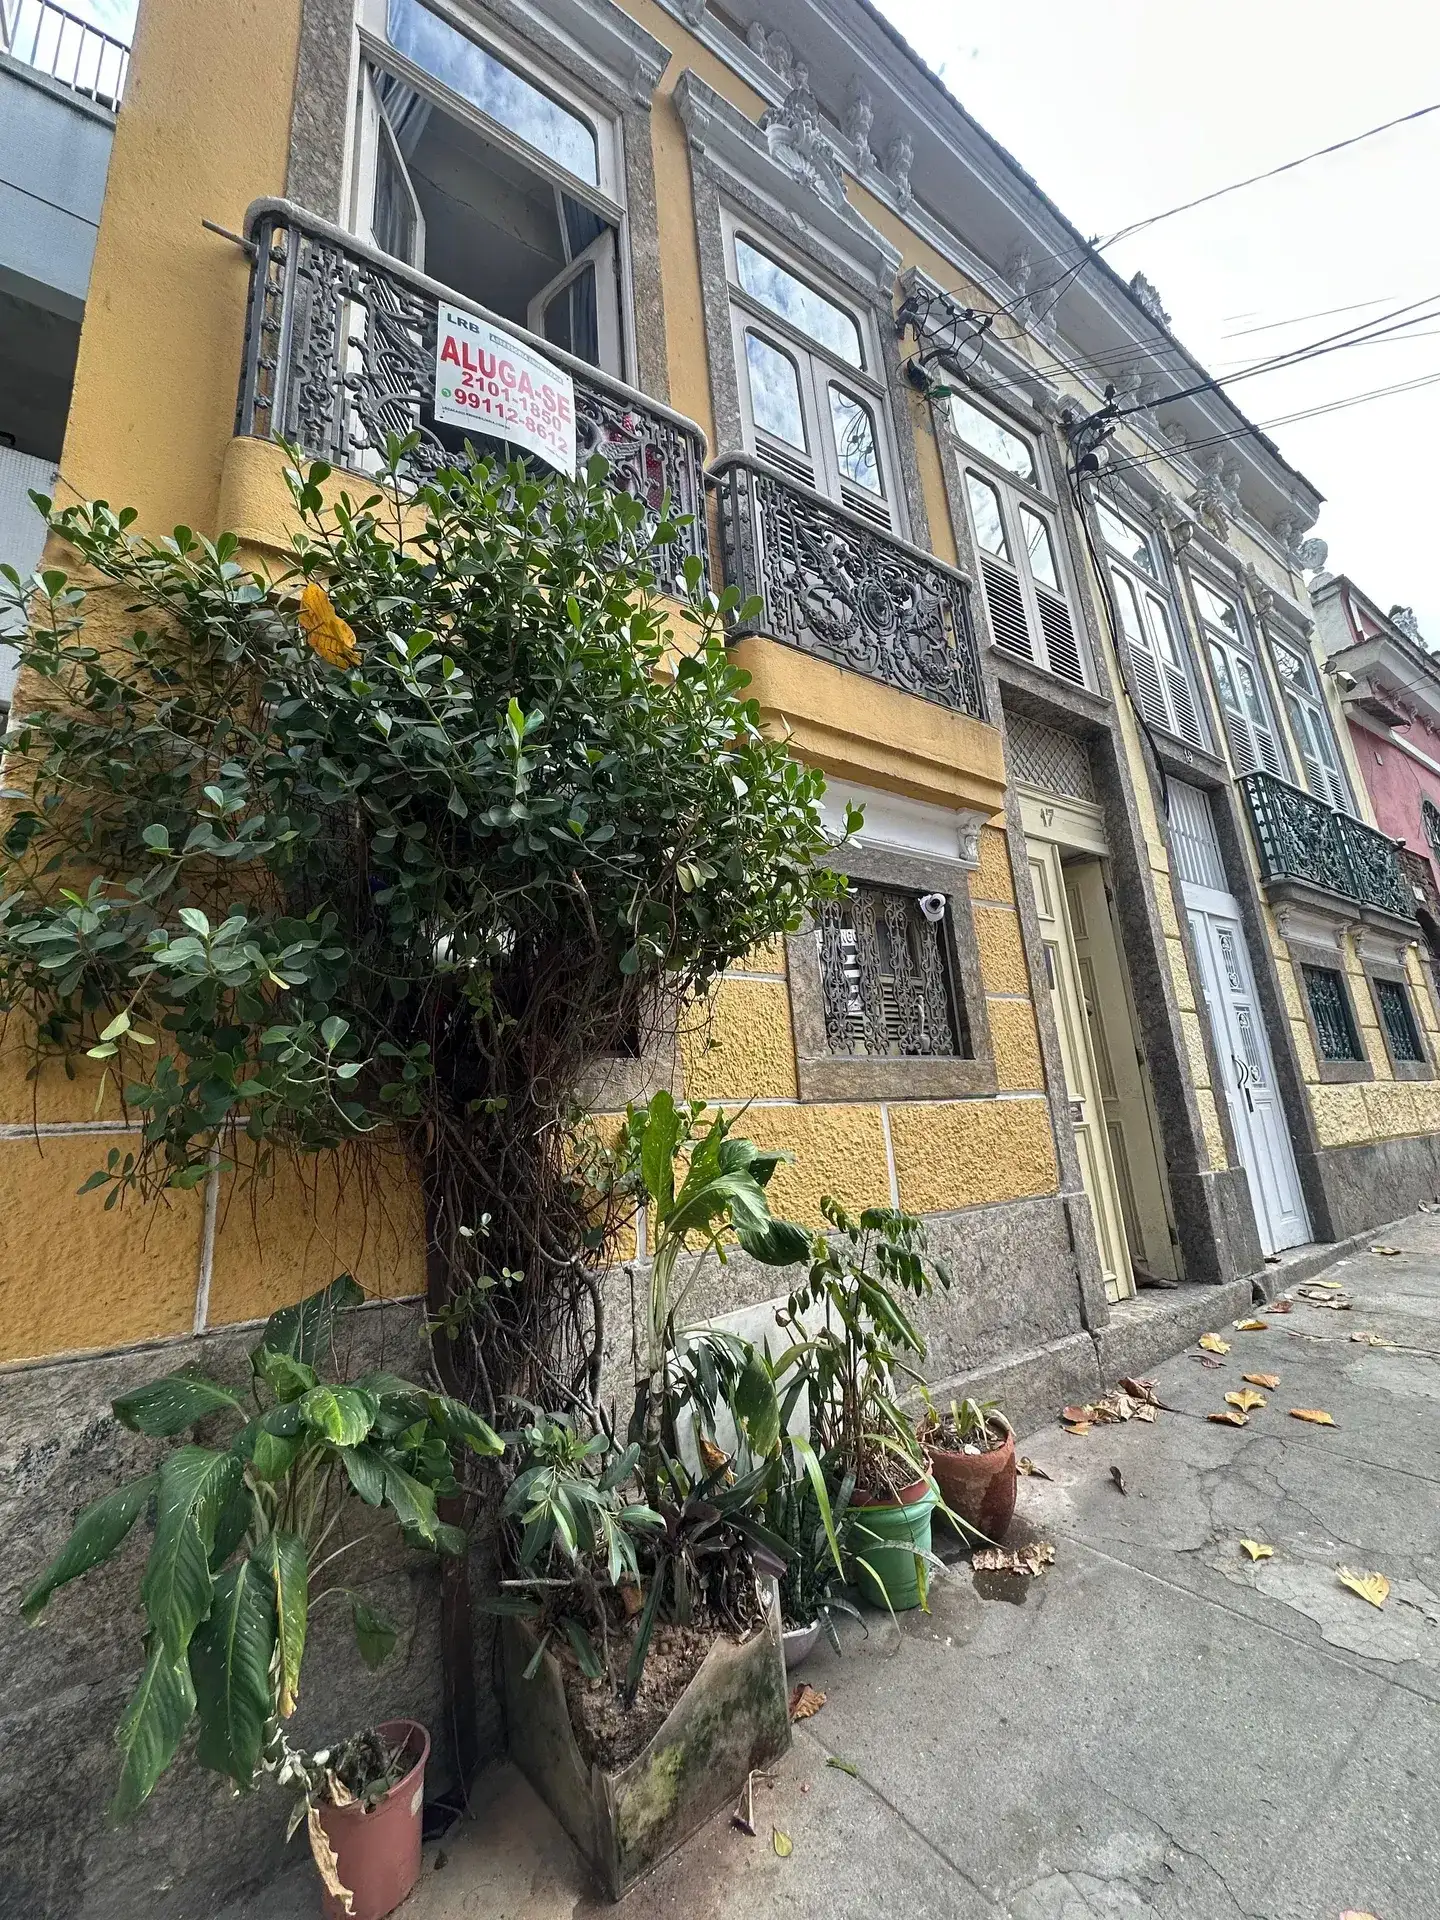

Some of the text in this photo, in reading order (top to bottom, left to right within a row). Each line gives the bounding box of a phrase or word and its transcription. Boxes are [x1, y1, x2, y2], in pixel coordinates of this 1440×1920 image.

[447, 313, 480, 334] LRB
[440, 335, 572, 424] ALUGA-SE
[461, 371, 562, 432] 2101-1850
[454, 388, 568, 455] 99112-8612
[1040, 808, 1054, 826] 17
